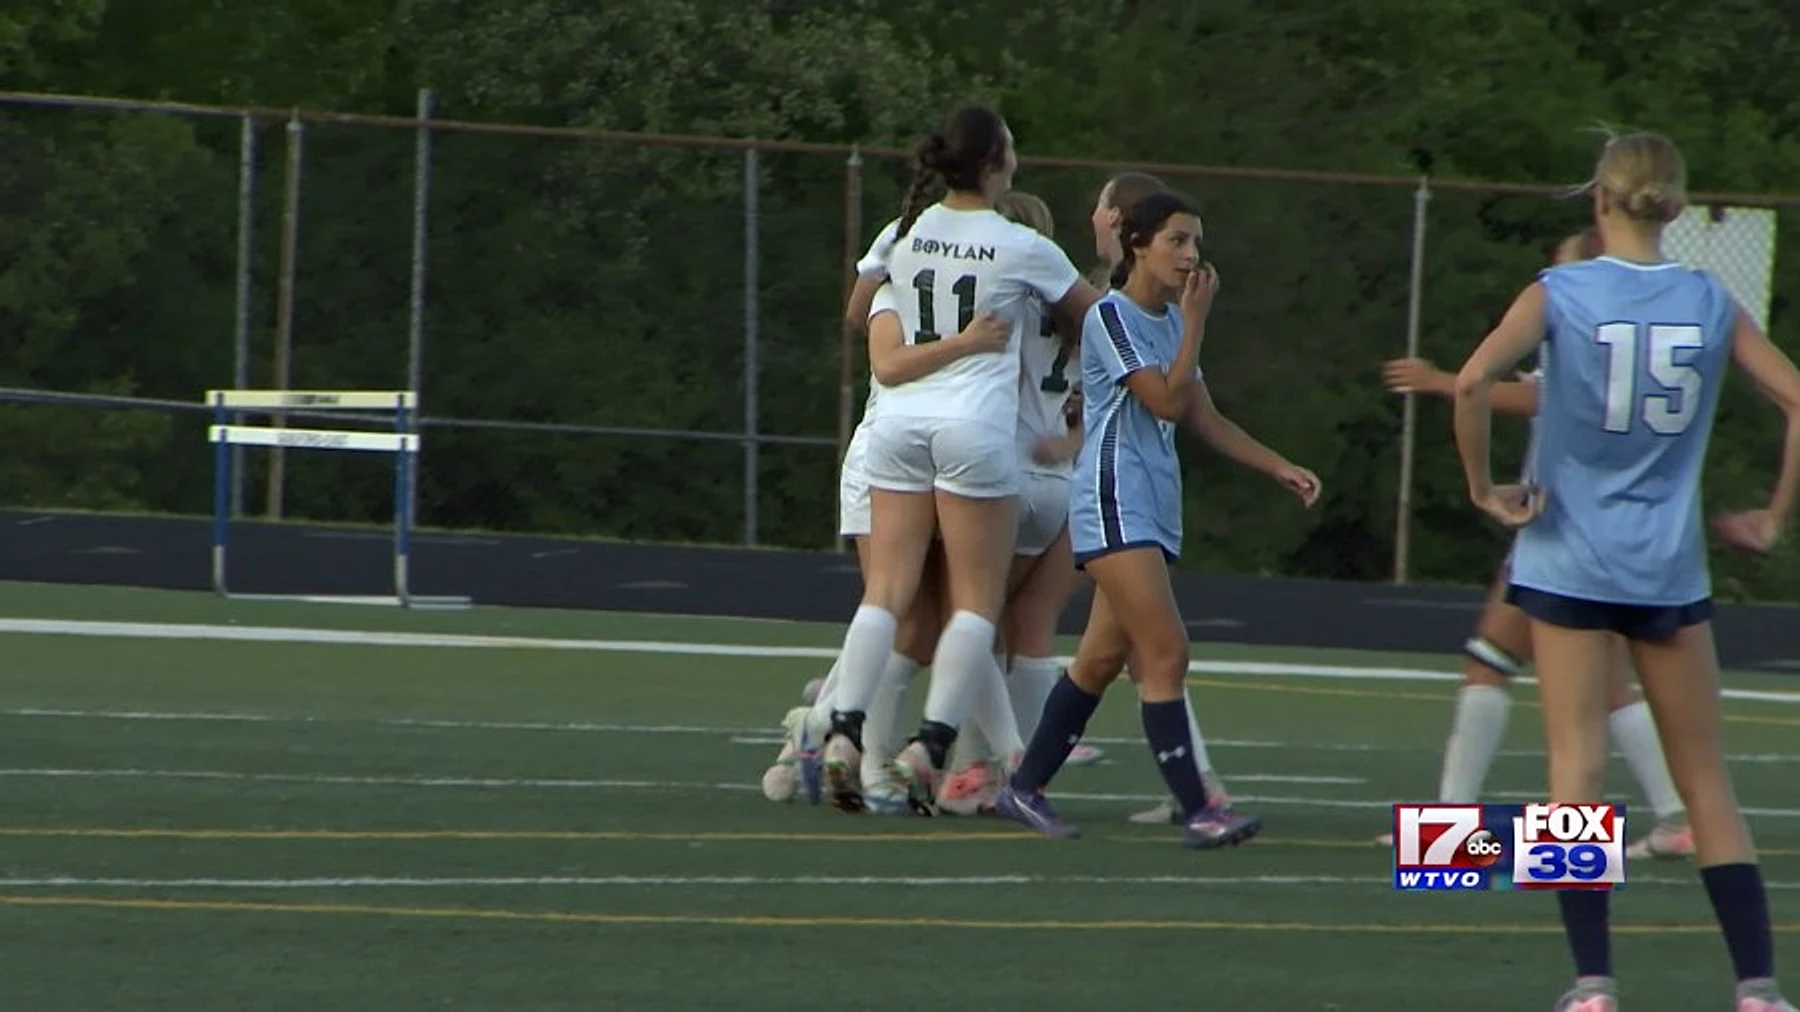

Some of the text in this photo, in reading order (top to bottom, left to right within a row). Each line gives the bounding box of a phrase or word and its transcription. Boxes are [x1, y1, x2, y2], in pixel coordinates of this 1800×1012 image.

[912, 237, 995, 262] BOYLAN
[912, 268, 977, 345] 11
[1594, 320, 1704, 437] 15
